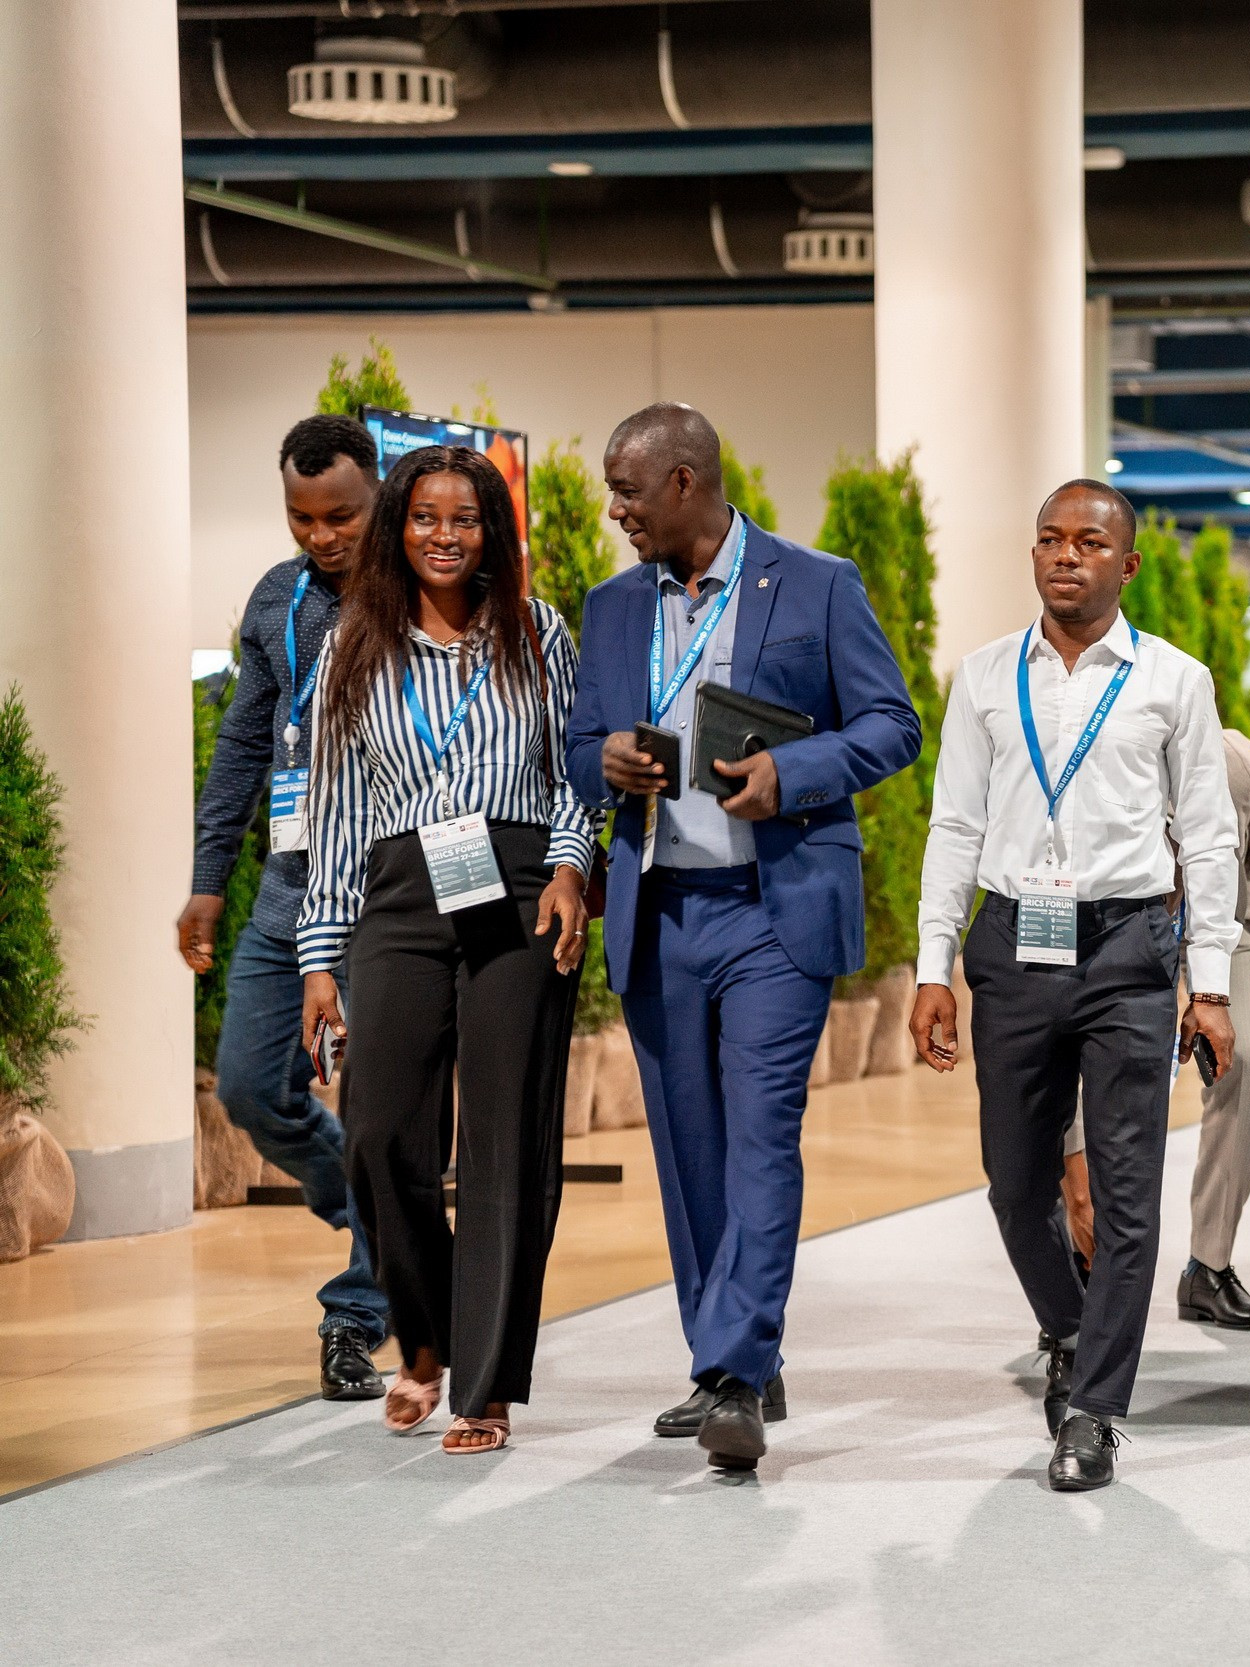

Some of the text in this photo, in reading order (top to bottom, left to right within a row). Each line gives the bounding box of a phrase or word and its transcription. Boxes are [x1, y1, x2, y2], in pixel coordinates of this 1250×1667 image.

[723, 565, 741, 598] IMBRICS
[703, 605, 722, 631] БРИКС
[652, 631, 661, 660] FORUM
[656, 652, 696, 714] IMBRICS FORUM
[1099, 687, 1117, 713] БРИКС
[440, 720, 460, 753] IMBRICS
[1054, 734, 1092, 798] IMBRICS FORUM
[427, 849, 454, 862] BRICS
[454, 839, 487, 855] FORUM
[1021, 898, 1074, 910] BRICS FORUM
